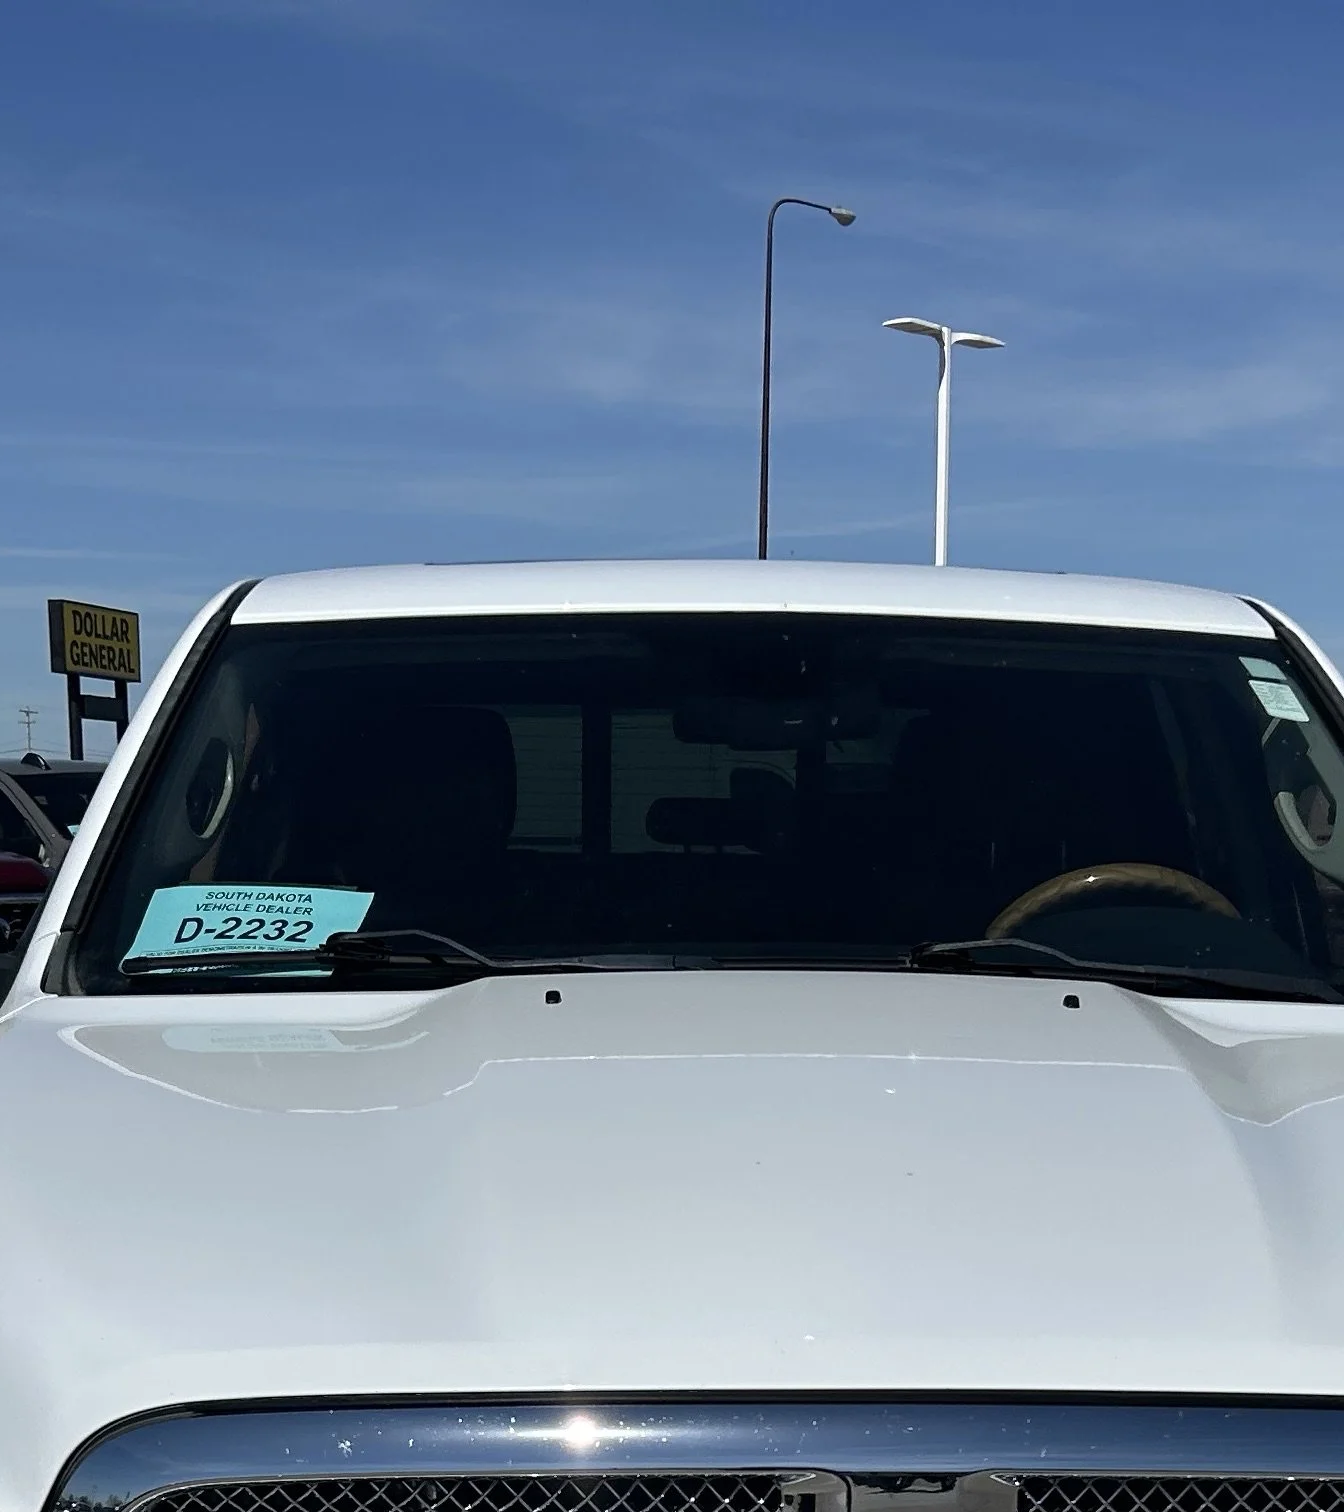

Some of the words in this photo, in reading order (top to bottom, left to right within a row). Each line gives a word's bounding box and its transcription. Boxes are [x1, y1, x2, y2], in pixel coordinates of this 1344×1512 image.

[71, 609, 130, 644] DOLLAR
[70, 640, 135, 674] GENERAL
[195, 903, 253, 913] VEHICLE
[255, 904, 314, 916] DEALER
[205, 891, 254, 900] SOUTH
[255, 892, 313, 904] DAKOTA
[173, 916, 315, 945] D-2232
